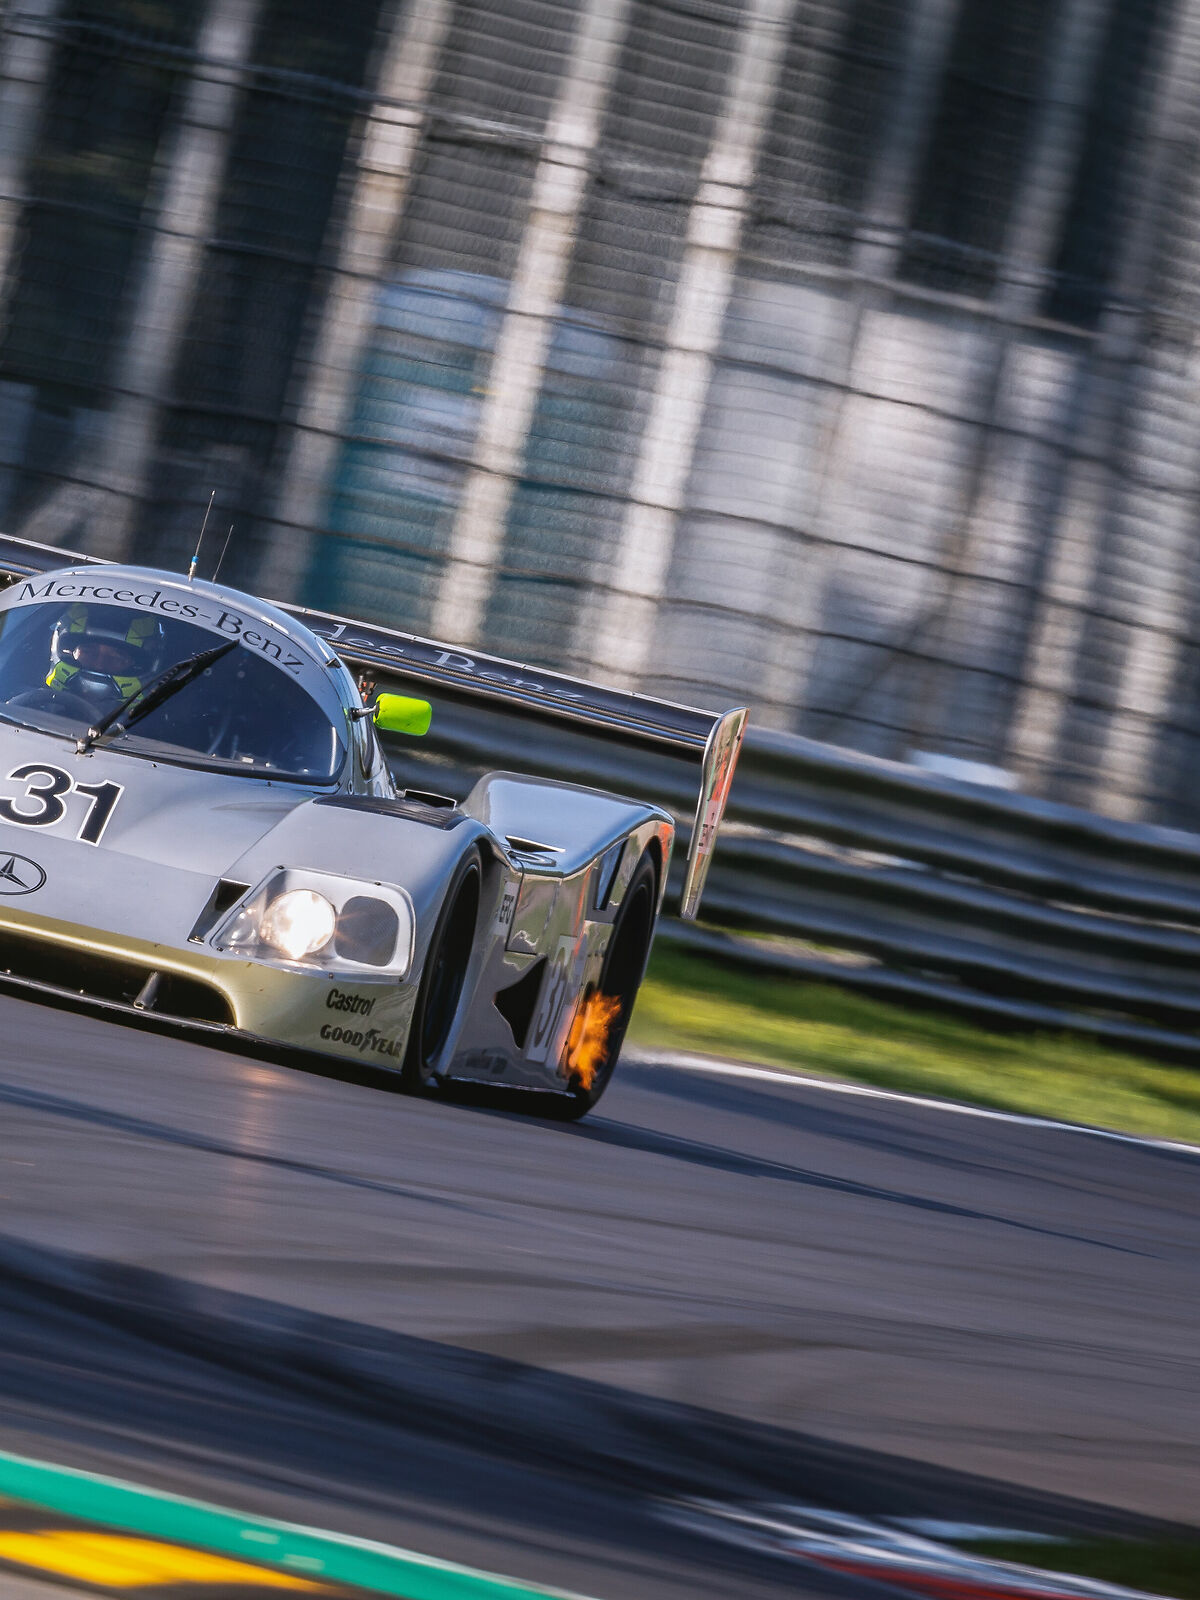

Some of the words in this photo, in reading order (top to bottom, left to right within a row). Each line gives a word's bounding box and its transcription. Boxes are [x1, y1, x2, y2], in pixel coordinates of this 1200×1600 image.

[18, 581, 305, 675] Mercedes-Benz
[423, 650, 585, 702] Benz
[326, 988, 376, 1017] Castrol
[320, 1023, 403, 1058] GOODYEAR
